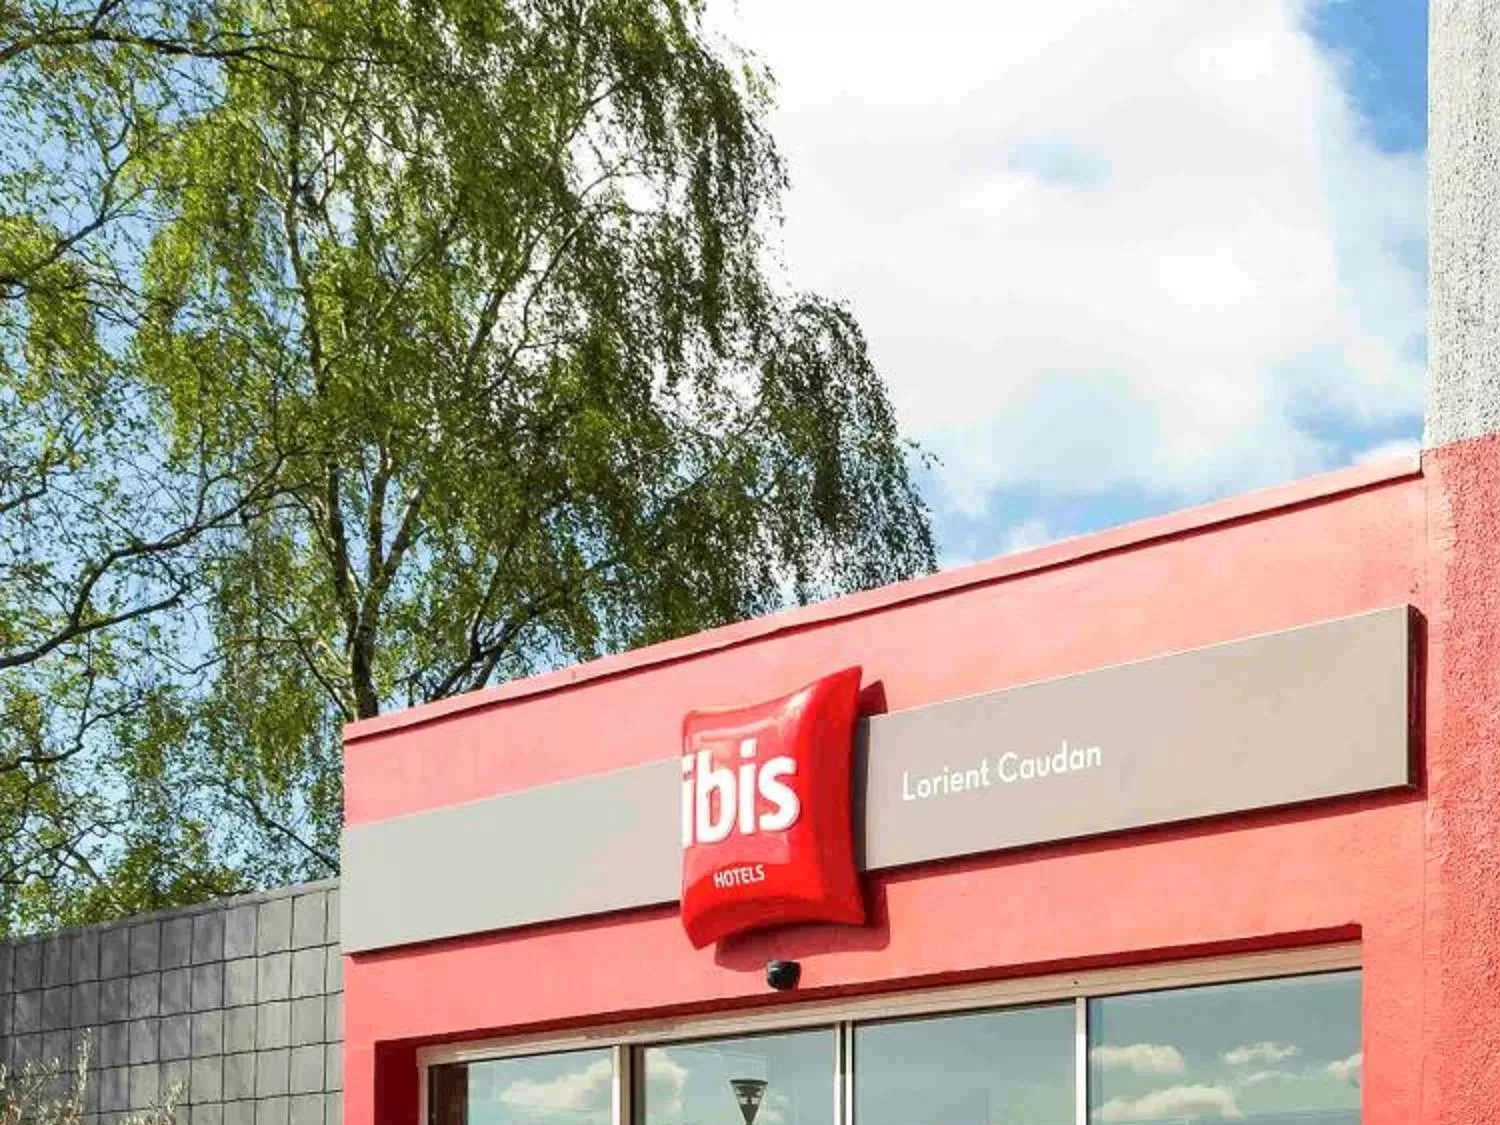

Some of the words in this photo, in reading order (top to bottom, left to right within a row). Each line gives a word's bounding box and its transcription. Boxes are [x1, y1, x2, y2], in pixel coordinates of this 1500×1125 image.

[680, 738, 800, 849] ibis
[902, 761, 991, 802] Lorient
[997, 740, 1103, 785] Caudan
[713, 864, 766, 889] HOTELS
